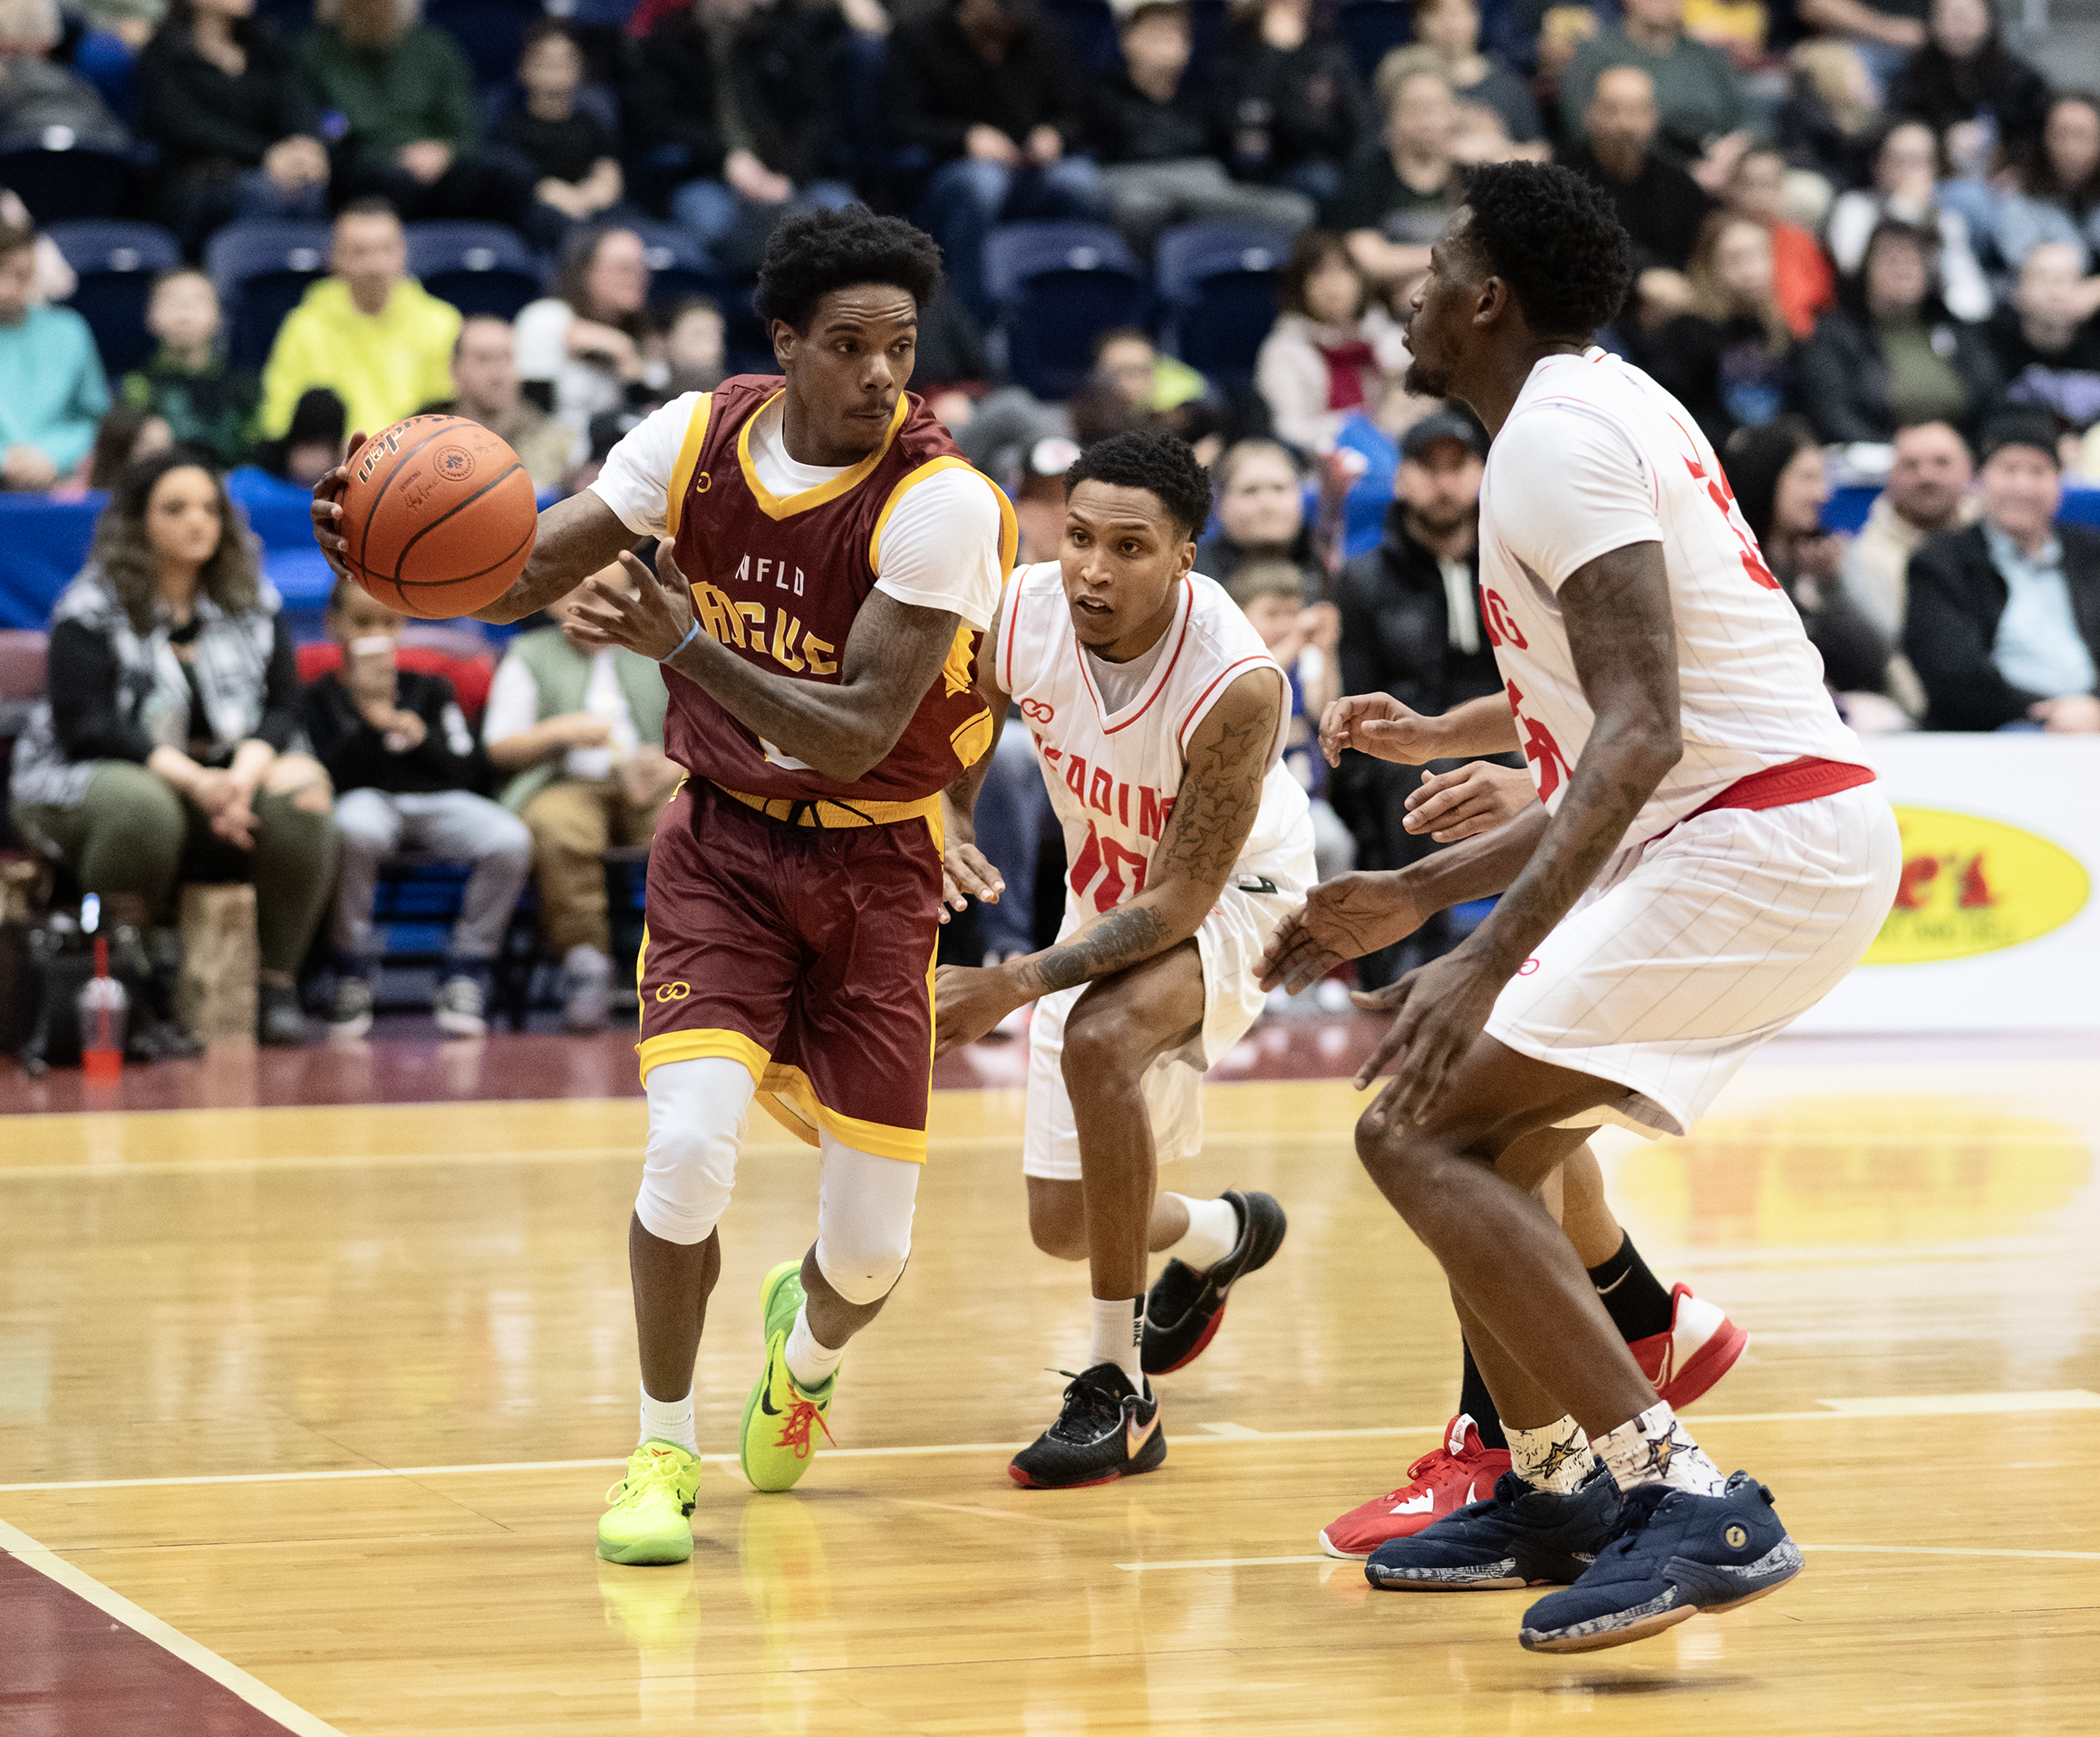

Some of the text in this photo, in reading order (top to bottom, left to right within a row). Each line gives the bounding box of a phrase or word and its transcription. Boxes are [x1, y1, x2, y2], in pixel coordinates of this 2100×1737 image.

[735, 553, 805, 597] NFLD
[1069, 818, 1148, 914] 10
[1133, 1320, 1142, 1347] NIKE
